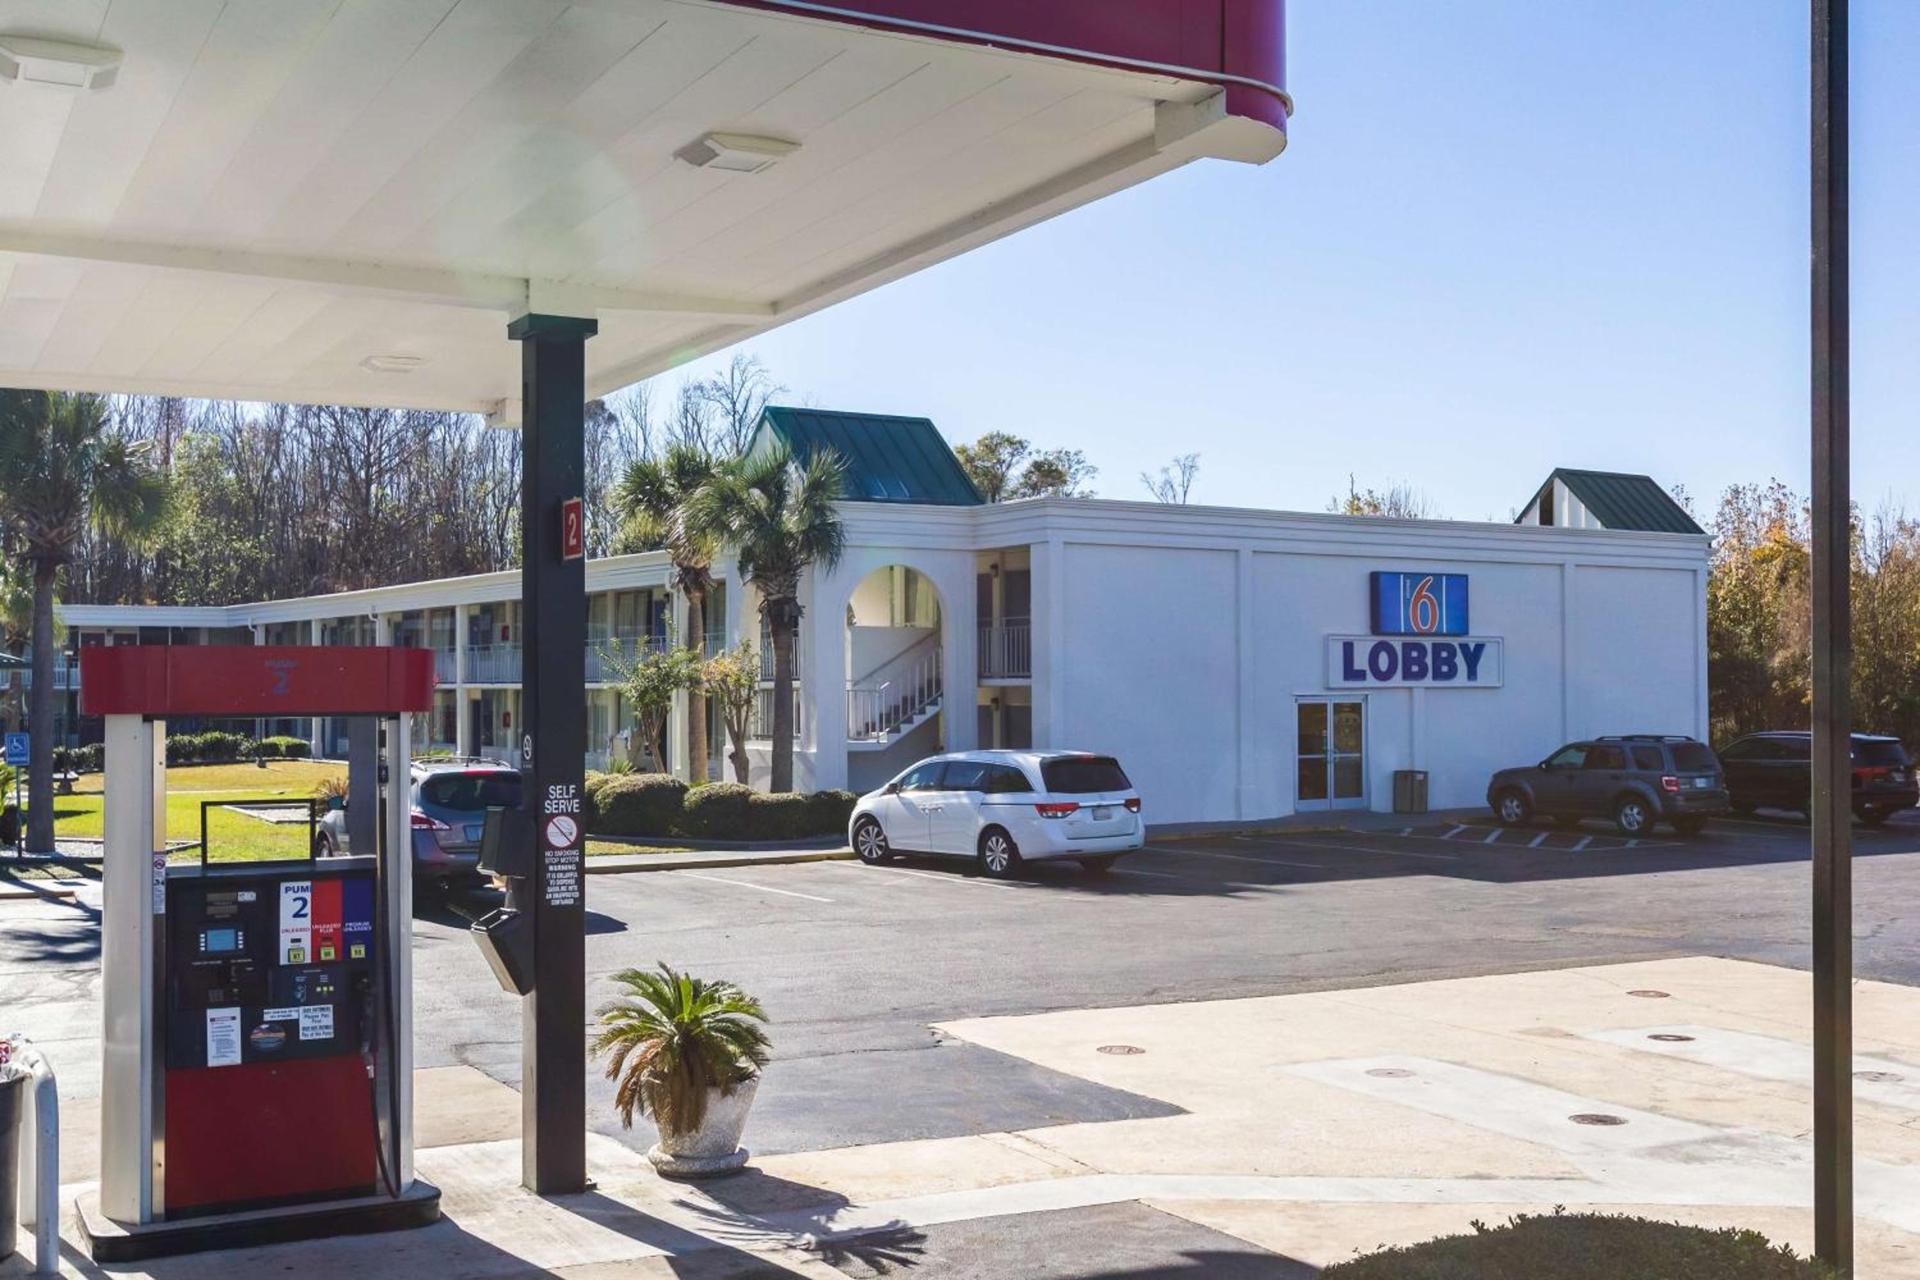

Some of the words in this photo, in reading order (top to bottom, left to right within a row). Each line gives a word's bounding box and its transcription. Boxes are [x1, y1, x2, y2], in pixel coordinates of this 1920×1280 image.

[568, 512, 577, 546] 2
[1409, 575, 1439, 634] 6
[1342, 640, 1486, 682] LOBBY
[548, 785, 577, 799] SELF
[544, 799, 580, 814] SERVE
[285, 885, 311, 894] PUM
[292, 896, 309, 919] 2
